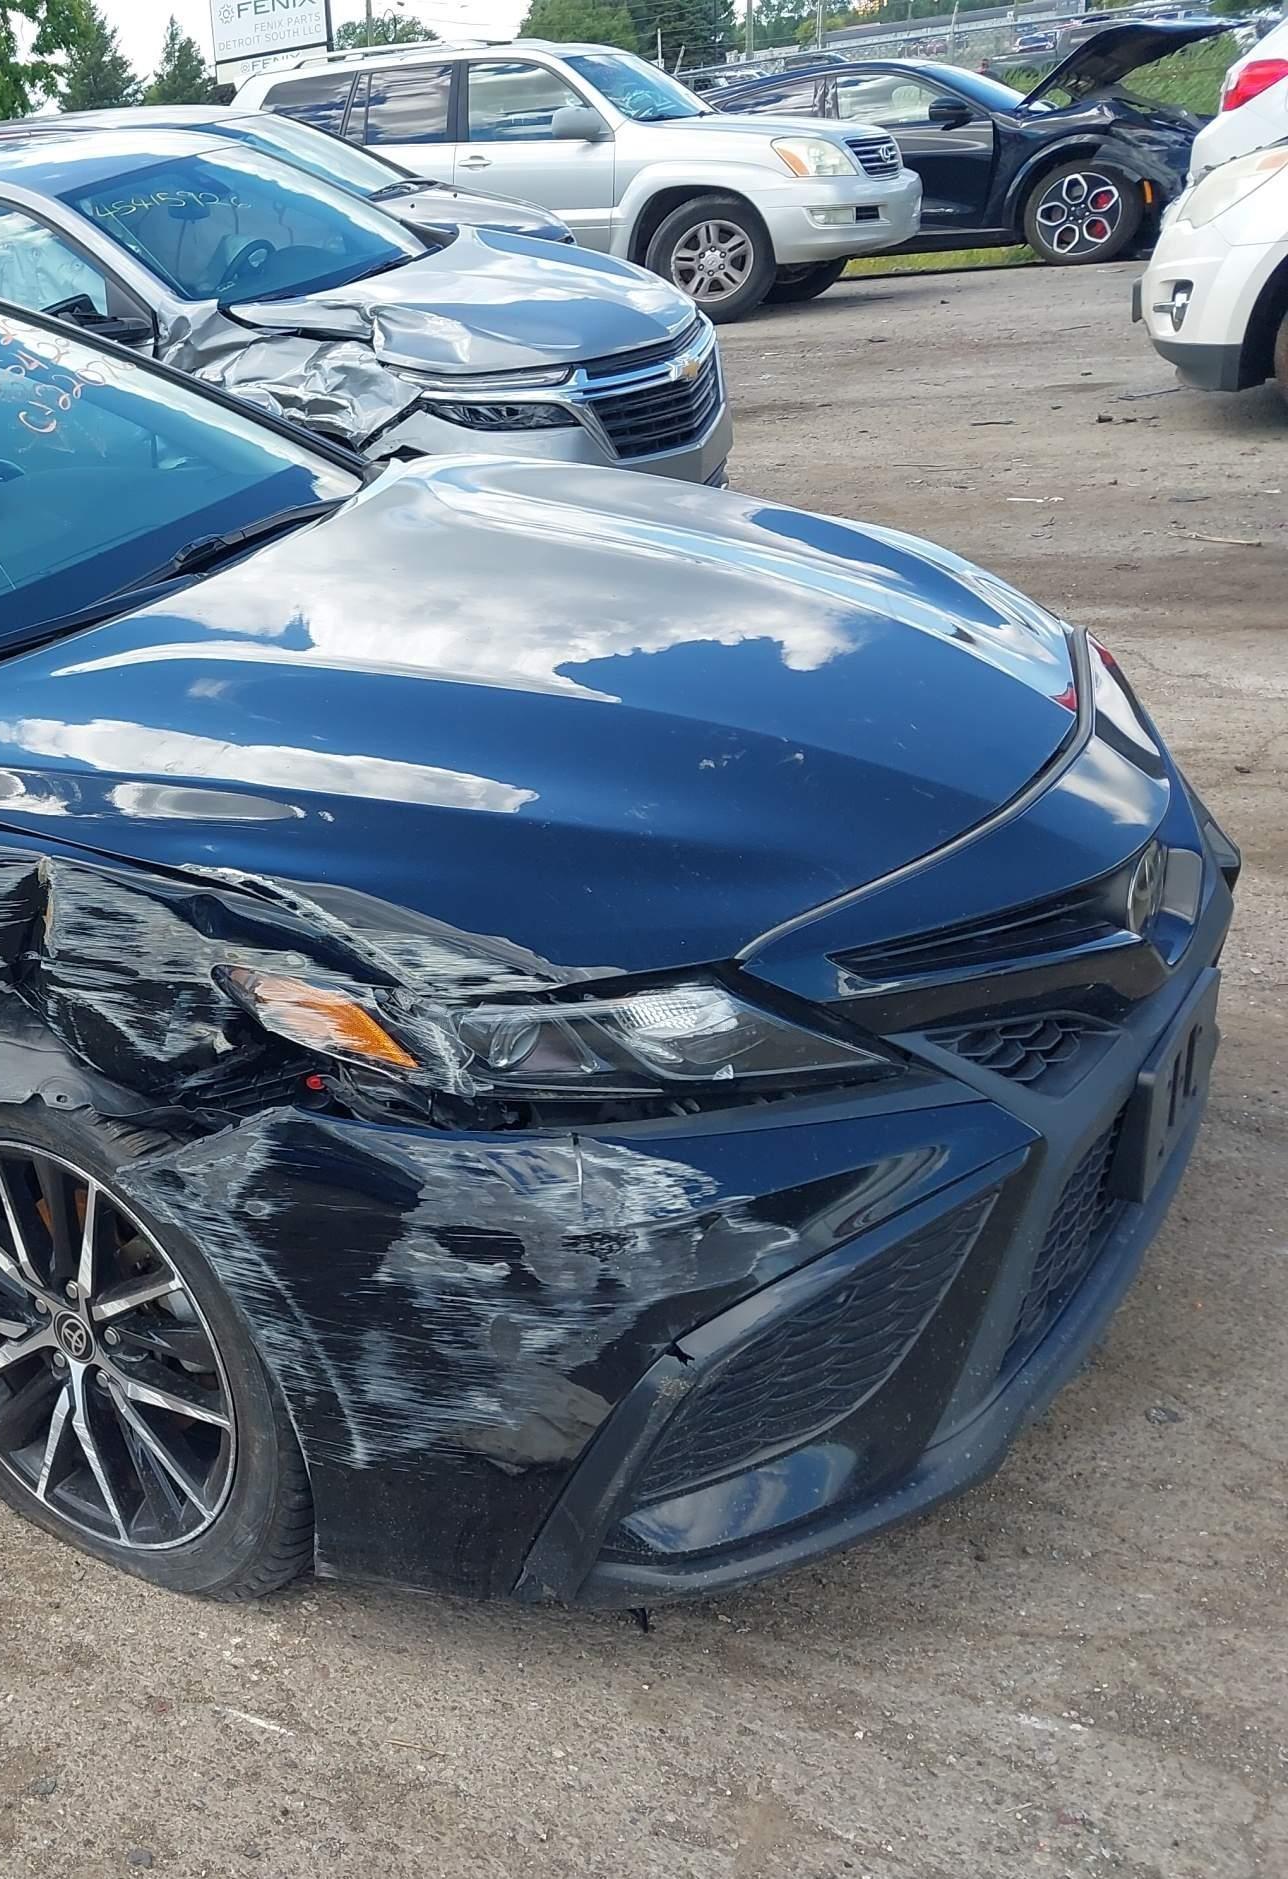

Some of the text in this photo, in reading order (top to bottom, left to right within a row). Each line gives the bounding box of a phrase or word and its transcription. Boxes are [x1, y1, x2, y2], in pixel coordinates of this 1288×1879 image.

[254, 12, 321, 33] FENIX PARTS
[218, 24, 322, 52] DETROIT SOUTH LLC
